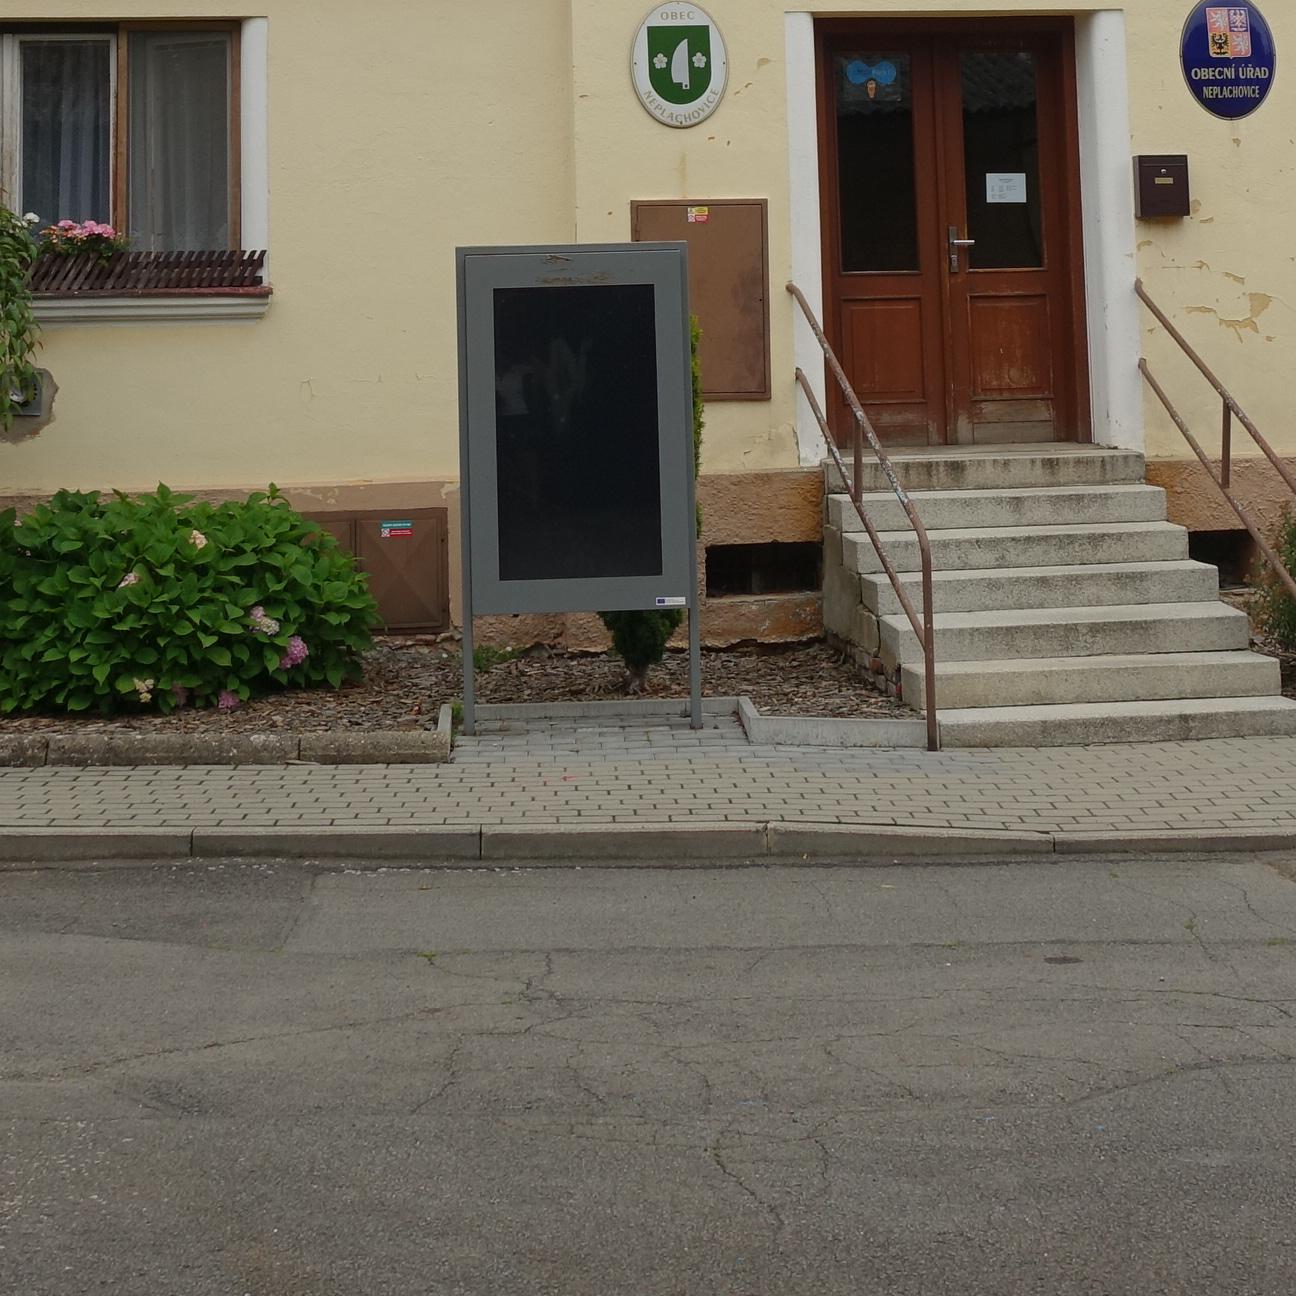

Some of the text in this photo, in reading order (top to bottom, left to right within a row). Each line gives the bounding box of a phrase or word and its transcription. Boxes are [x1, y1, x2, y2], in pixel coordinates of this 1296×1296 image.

[660, 10, 696, 21] OBEC
[1191, 63, 1269, 80] OBECNÍ ÚŘAD
[1203, 86, 1260, 99] NEPLACHOVICE
[643, 88, 719, 124] NEPLACHOVICE
